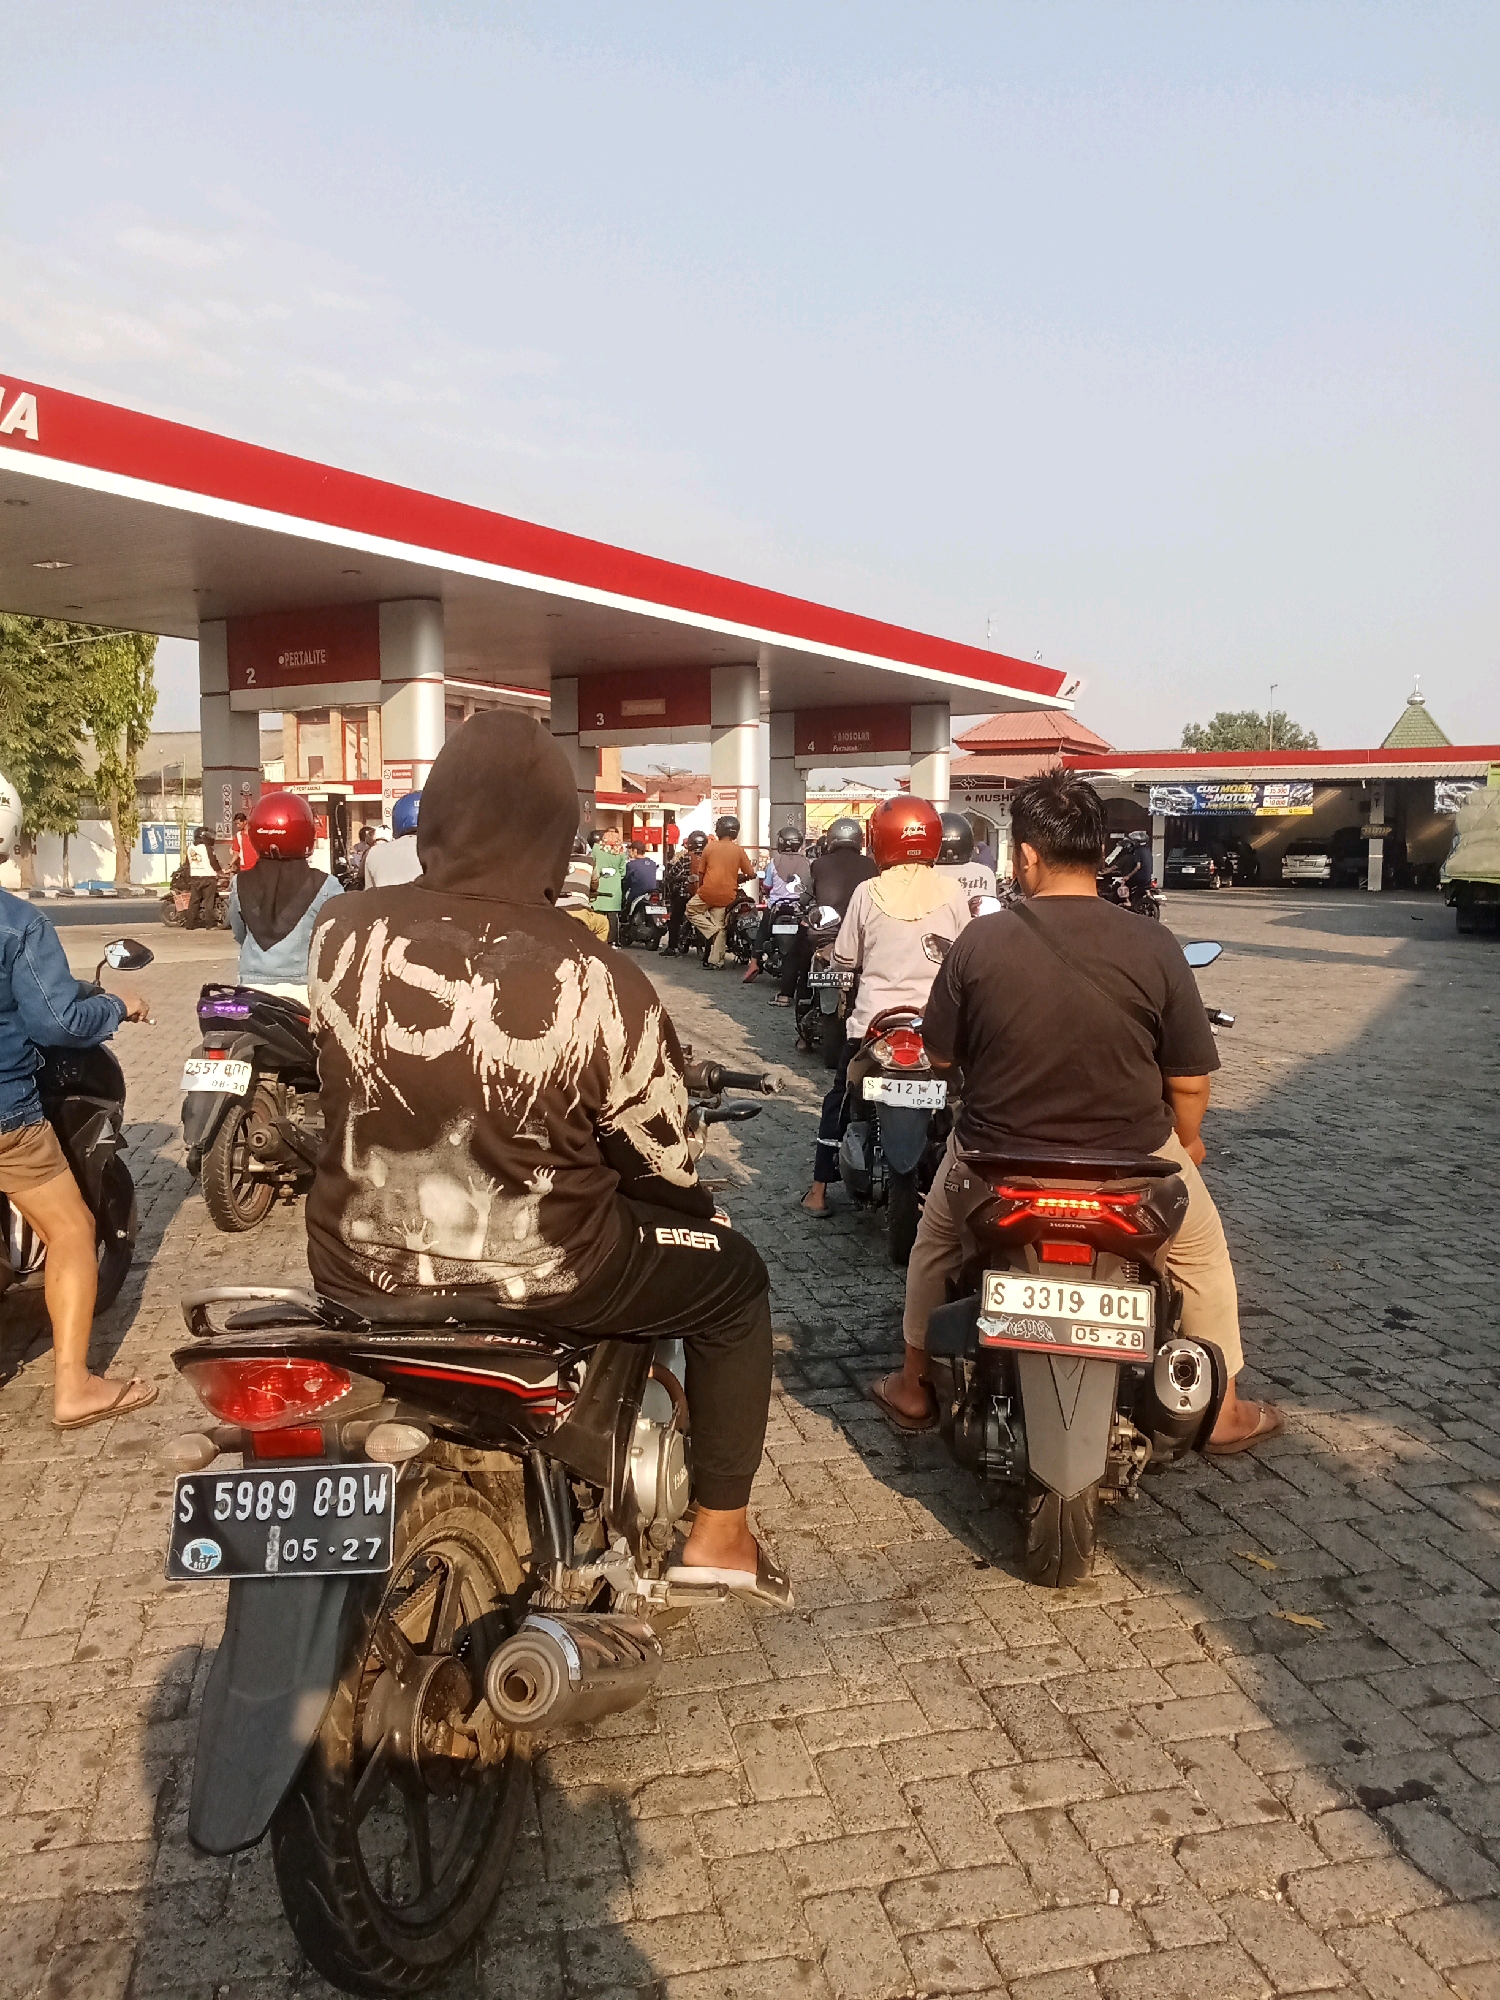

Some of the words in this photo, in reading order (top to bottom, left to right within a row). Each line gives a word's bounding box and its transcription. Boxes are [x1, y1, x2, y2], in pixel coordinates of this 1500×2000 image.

[0, 386, 39, 441] A
[284, 649, 326, 666] PERTALITE
[246, 668, 256, 684] 2
[596, 712, 605, 726] 3
[807, 740, 815, 751] 4
[1220, 784, 1254, 793] MOBIL
[1213, 794, 1256, 802] MOTOR
[867, 1080, 875, 1090] S
[655, 1227, 721, 1251] EIGER
[992, 1282, 1006, 1305] S
[1022, 1286, 1084, 1313] 3319
[179, 1484, 195, 1523] S
[213, 1479, 296, 1521] 5989
